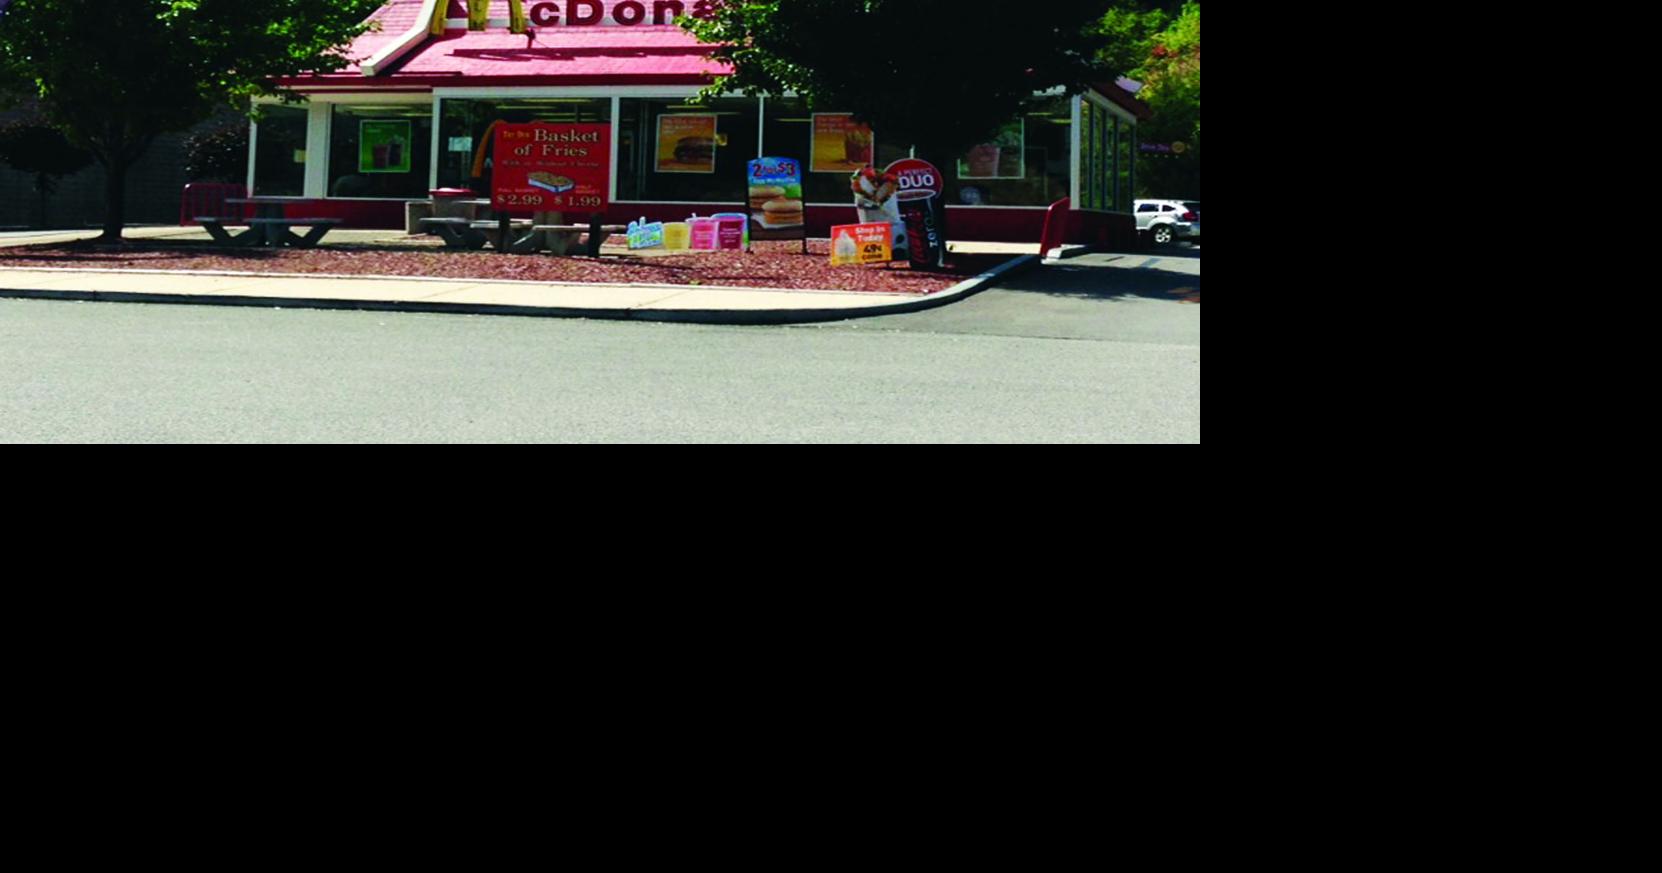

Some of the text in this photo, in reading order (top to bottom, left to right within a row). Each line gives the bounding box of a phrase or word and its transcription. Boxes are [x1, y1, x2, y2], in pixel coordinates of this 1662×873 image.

[534, 128, 598, 142] Basket
[514, 144, 588, 156] of Fries
[753, 164, 762, 177] 2
[898, 174, 934, 189] DUO
